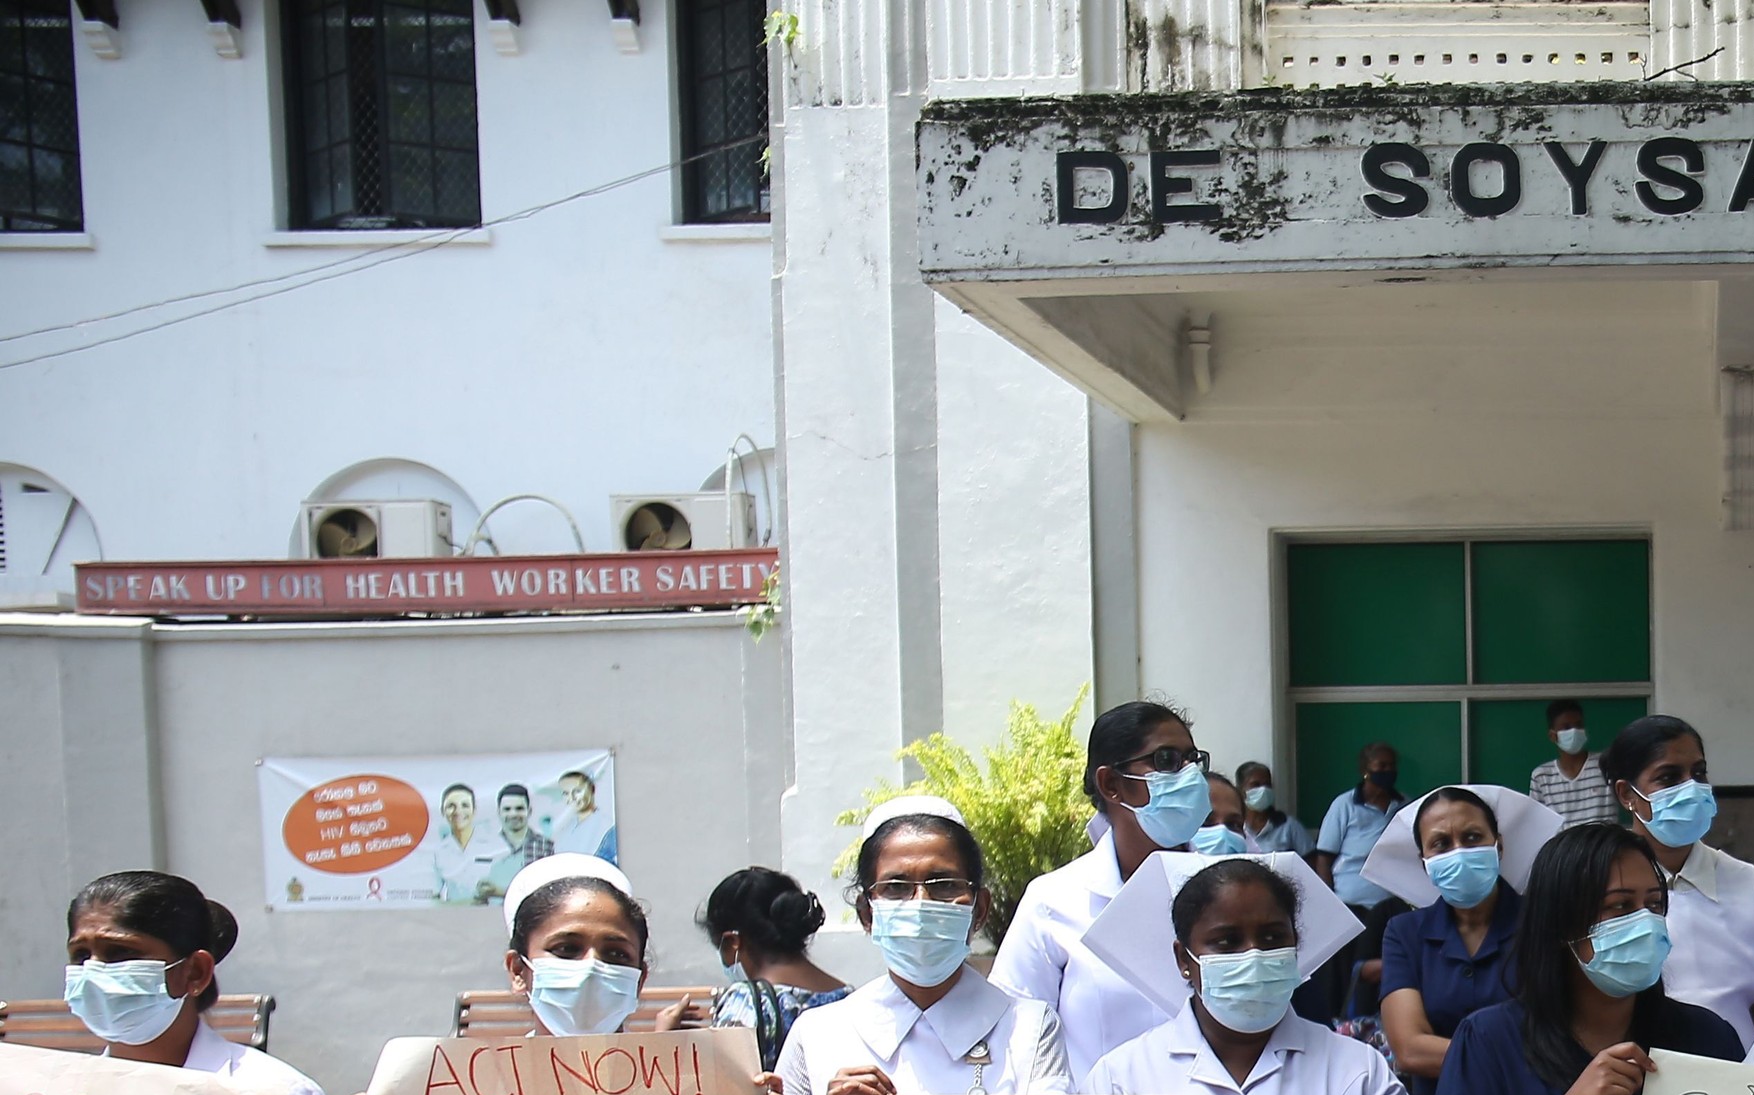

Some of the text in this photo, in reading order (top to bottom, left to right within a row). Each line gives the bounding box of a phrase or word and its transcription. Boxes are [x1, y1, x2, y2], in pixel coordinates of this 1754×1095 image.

[1055, 149, 1222, 225] DE
[85, 572, 192, 603] SPEAK
[204, 572, 248, 602] UP
[260, 573, 324, 601] FOR
[345, 569, 465, 601] HEALTH
[490, 566, 642, 598] WORKER
